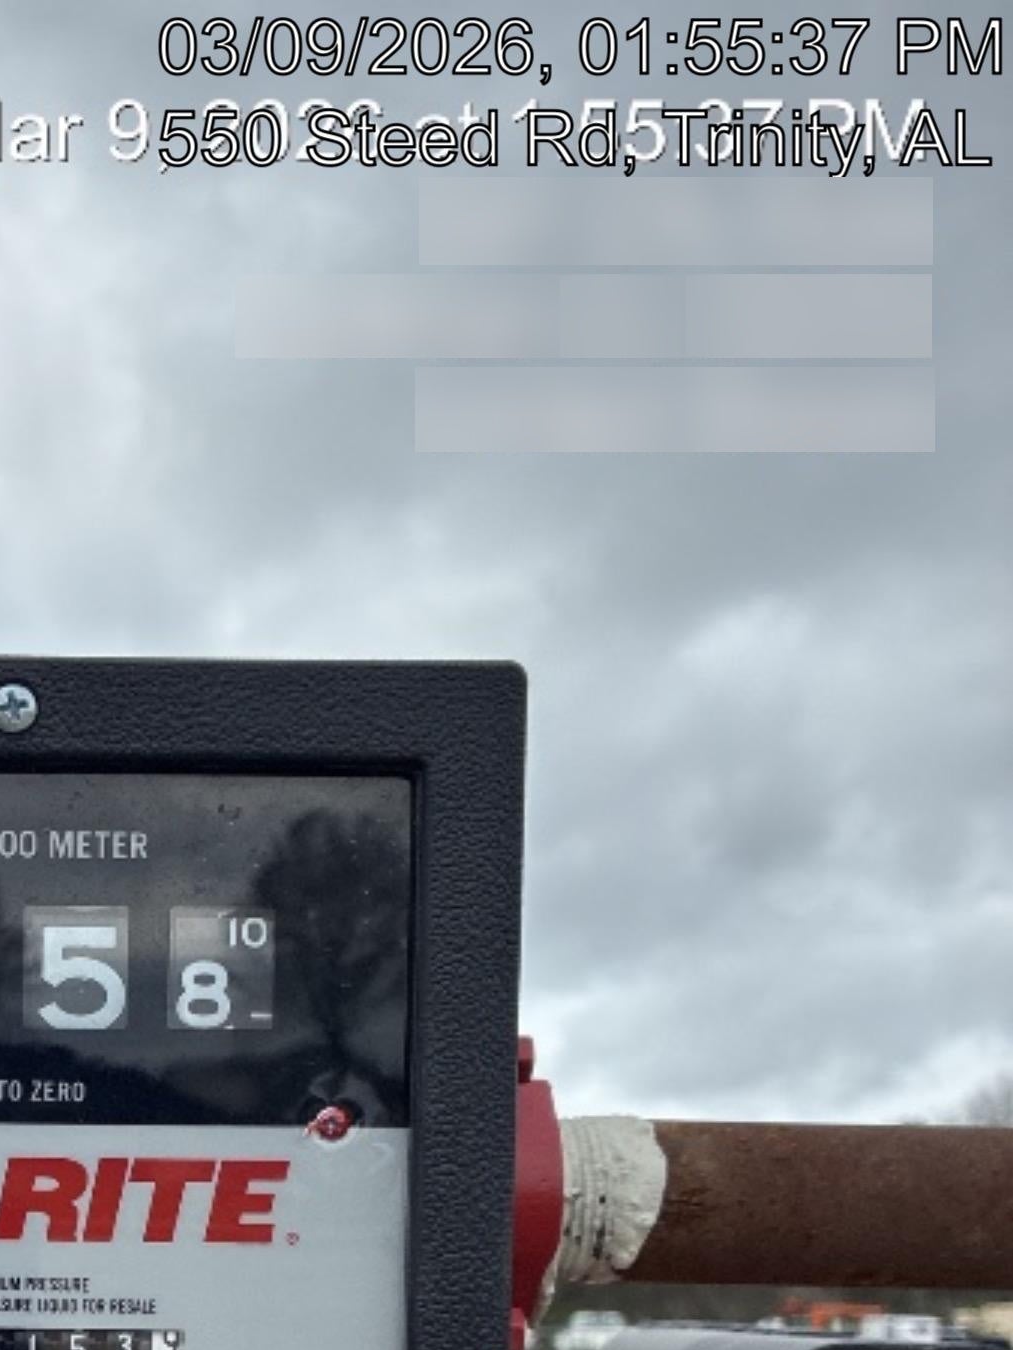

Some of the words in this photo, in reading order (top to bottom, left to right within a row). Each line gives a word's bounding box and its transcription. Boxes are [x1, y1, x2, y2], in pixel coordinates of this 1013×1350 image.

[48, 830, 148, 859] METER
[228, 917, 267, 948] 10
[30, 1080, 86, 1103] ZERO
[24, 1277, 91, 1293] PRESSURE
[38, 1299, 79, 1314] LIQUID
[82, 1299, 106, 1314] FOR
[109, 1300, 157, 1315] RESALE
